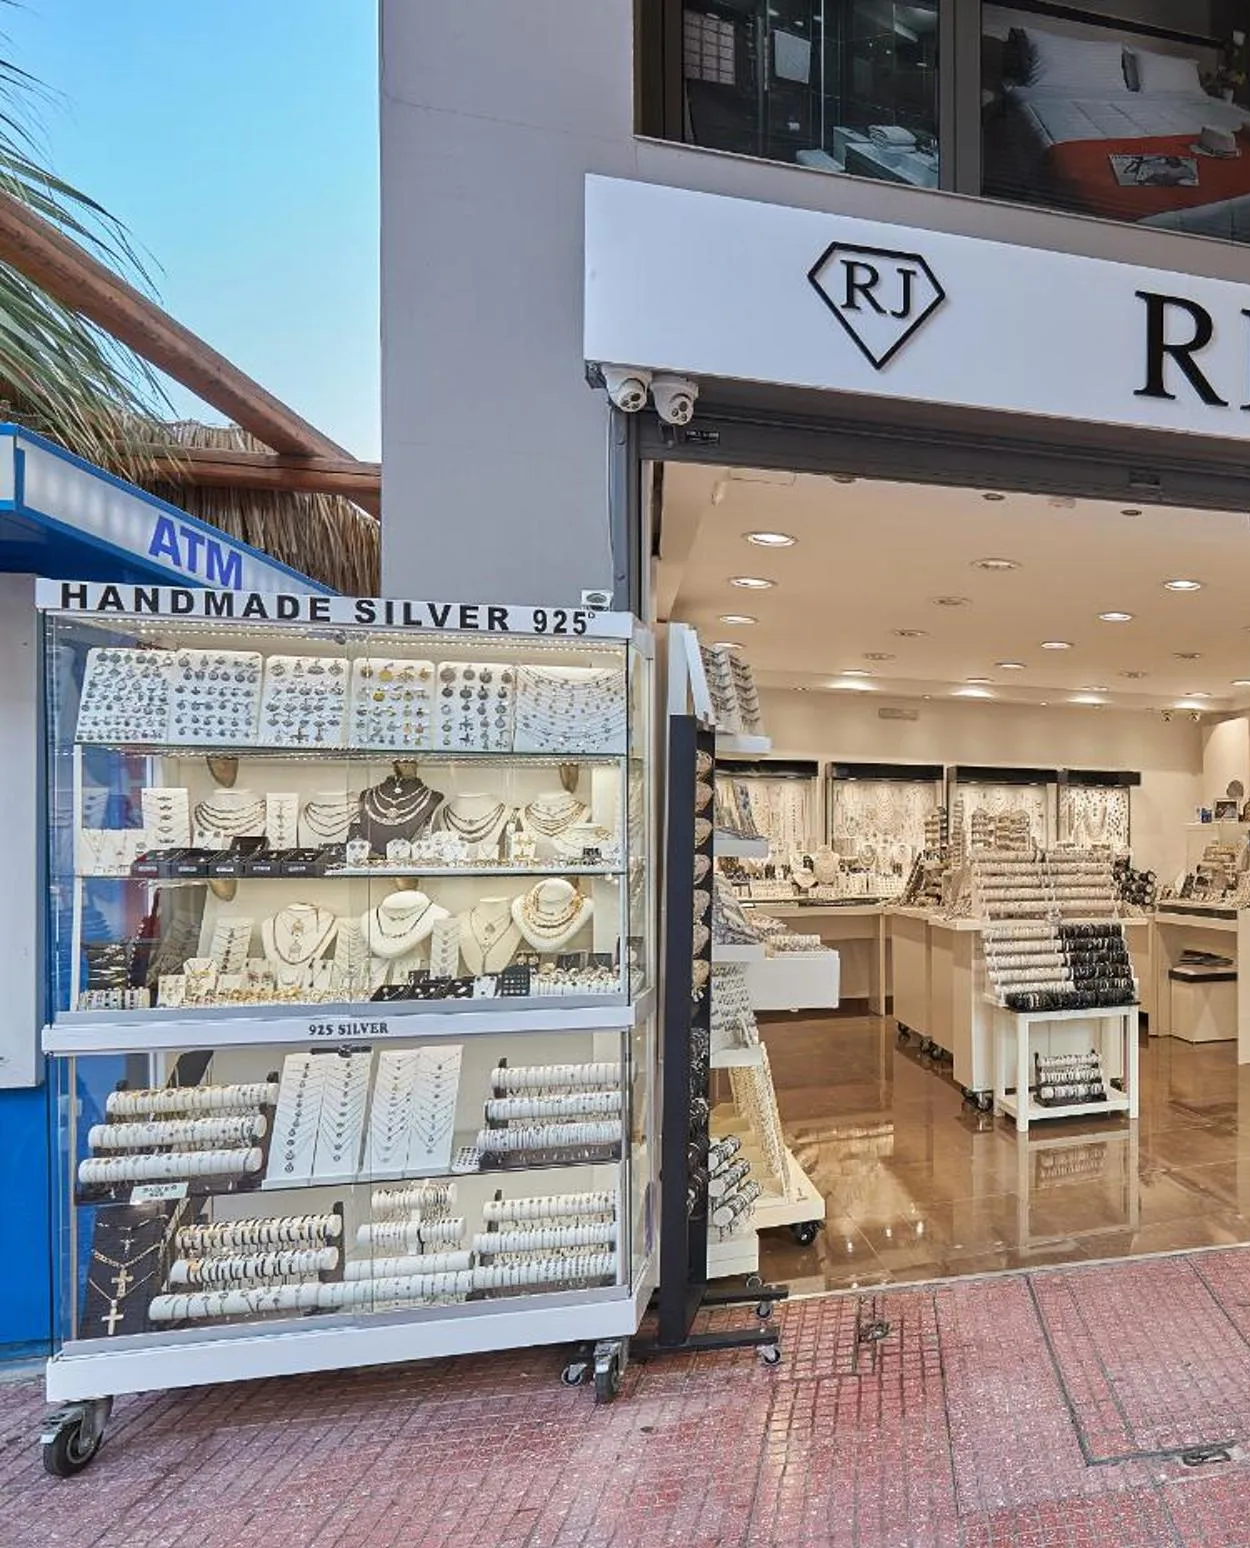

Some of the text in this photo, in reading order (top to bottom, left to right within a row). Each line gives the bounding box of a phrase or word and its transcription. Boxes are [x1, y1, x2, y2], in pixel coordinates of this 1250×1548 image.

[840, 259, 916, 319] RJ
[149, 515, 242, 590] ATM
[61, 583, 331, 622] HANDMADE
[355, 600, 510, 631] SILVER
[309, 1022, 389, 1036] 925 SILVER
